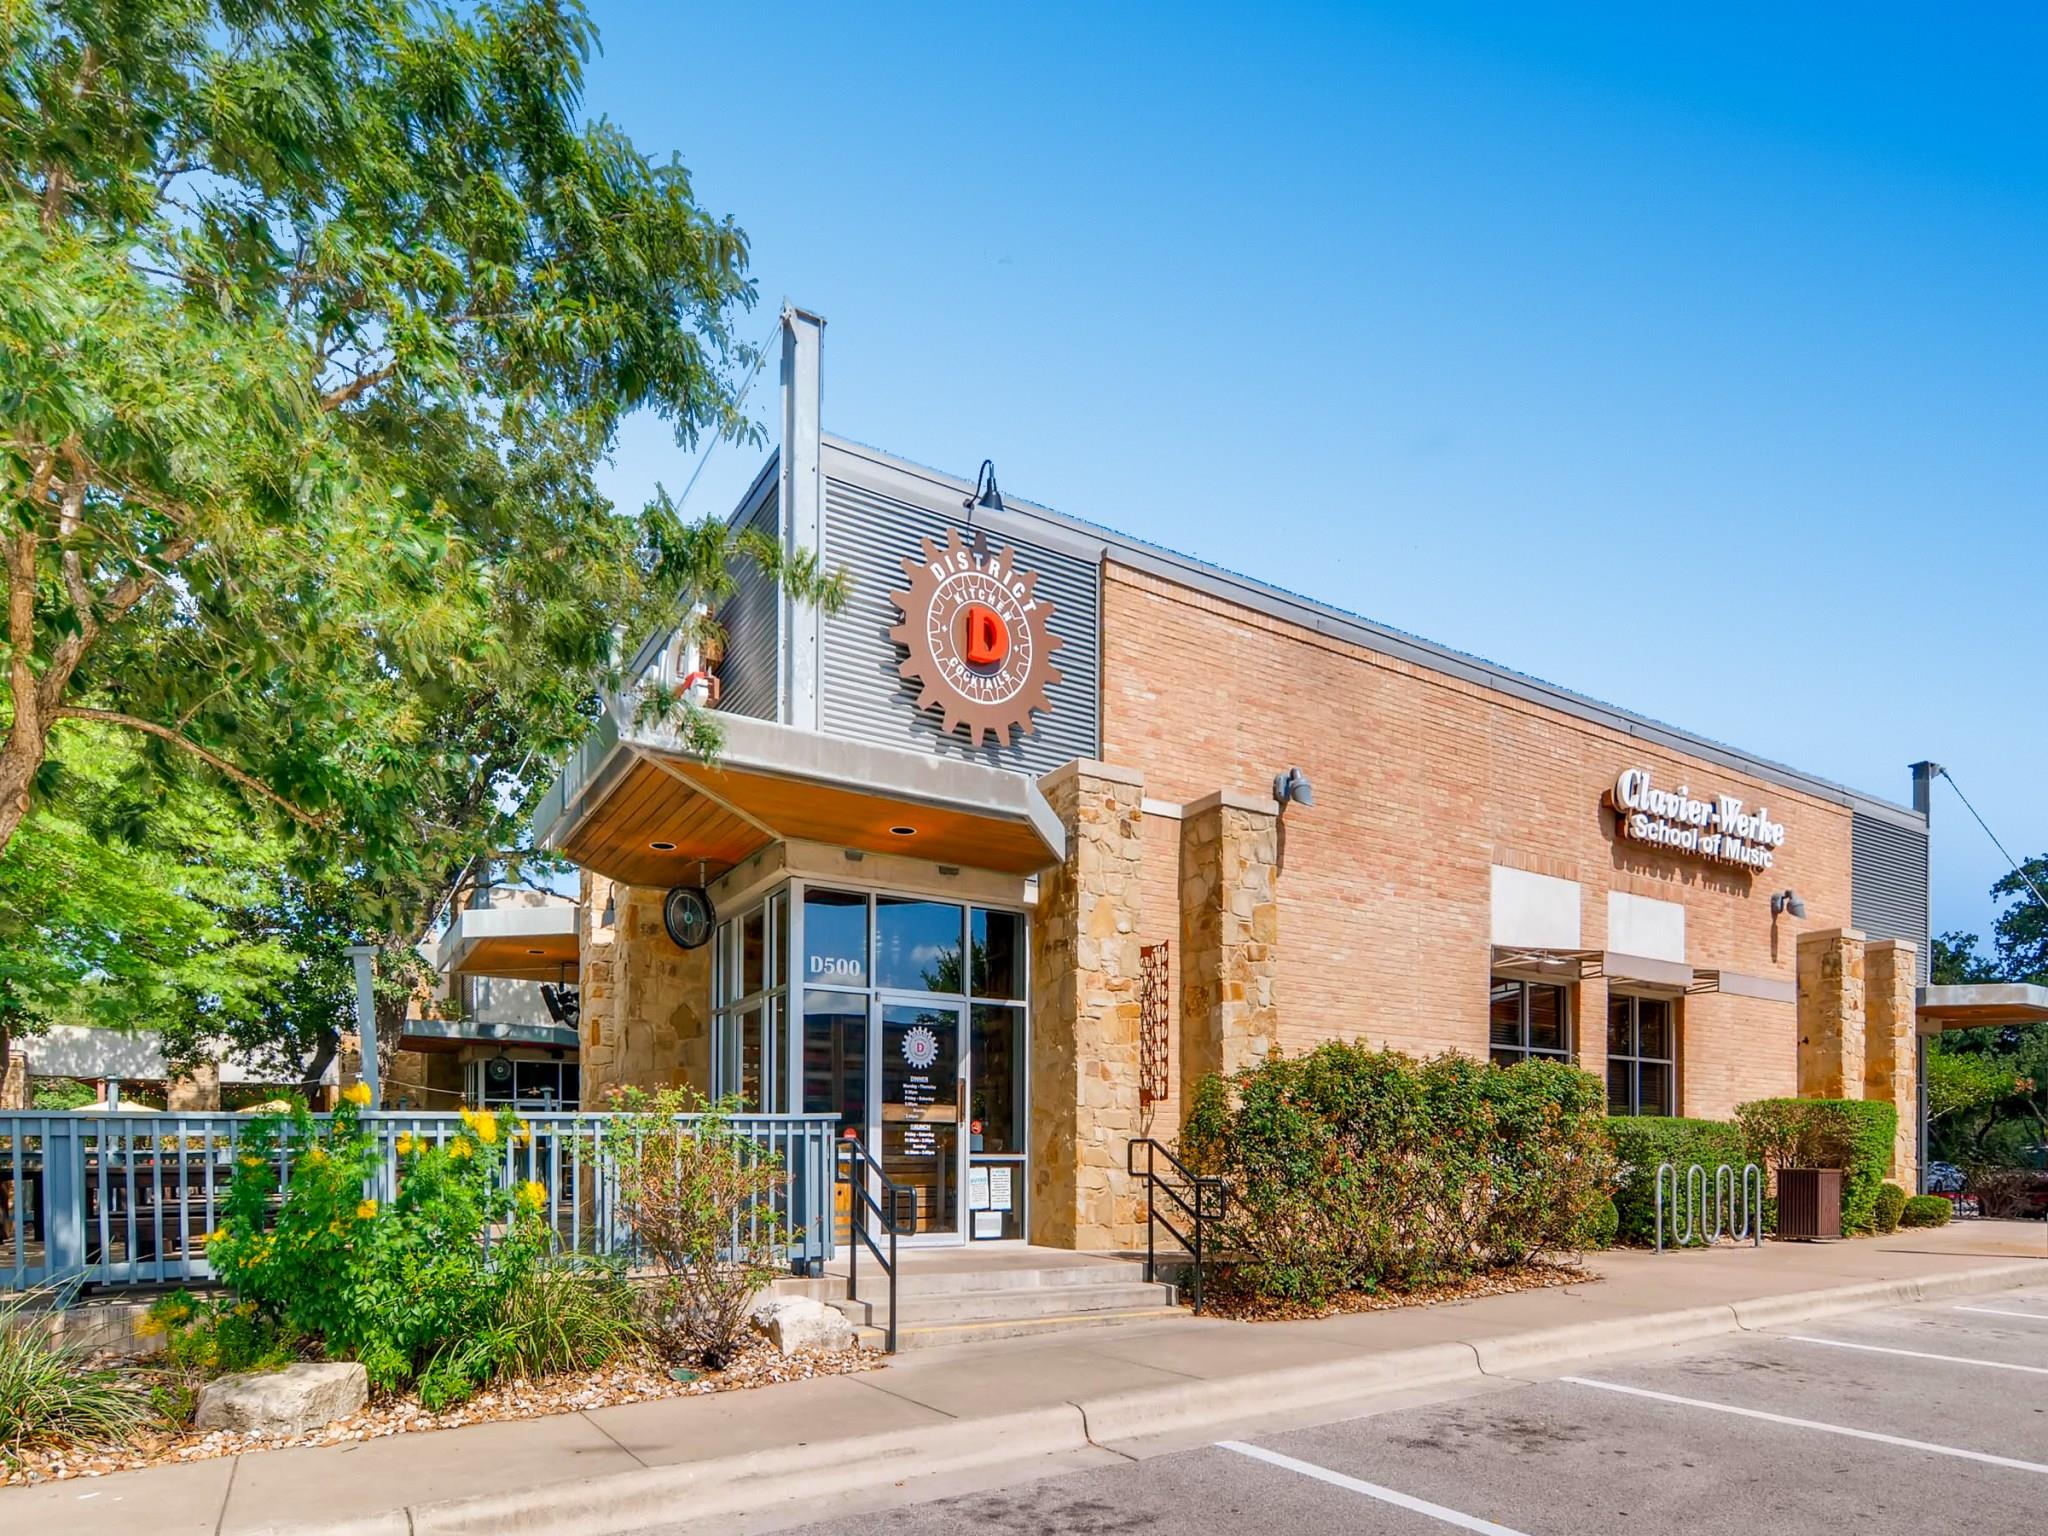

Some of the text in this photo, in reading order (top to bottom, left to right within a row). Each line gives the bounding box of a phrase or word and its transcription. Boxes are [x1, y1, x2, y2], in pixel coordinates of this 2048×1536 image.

[930, 551, 1037, 613] DISTRICT
[953, 587, 1012, 622] KITCHEN
[968, 606, 1008, 663] D
[949, 656, 1012, 690] COCKTAILS
[1614, 768, 1784, 846] Clavier-Werke
[1631, 813, 1774, 869] School of Music
[810, 955, 861, 977] D500
[916, 1042, 925, 1053] D
